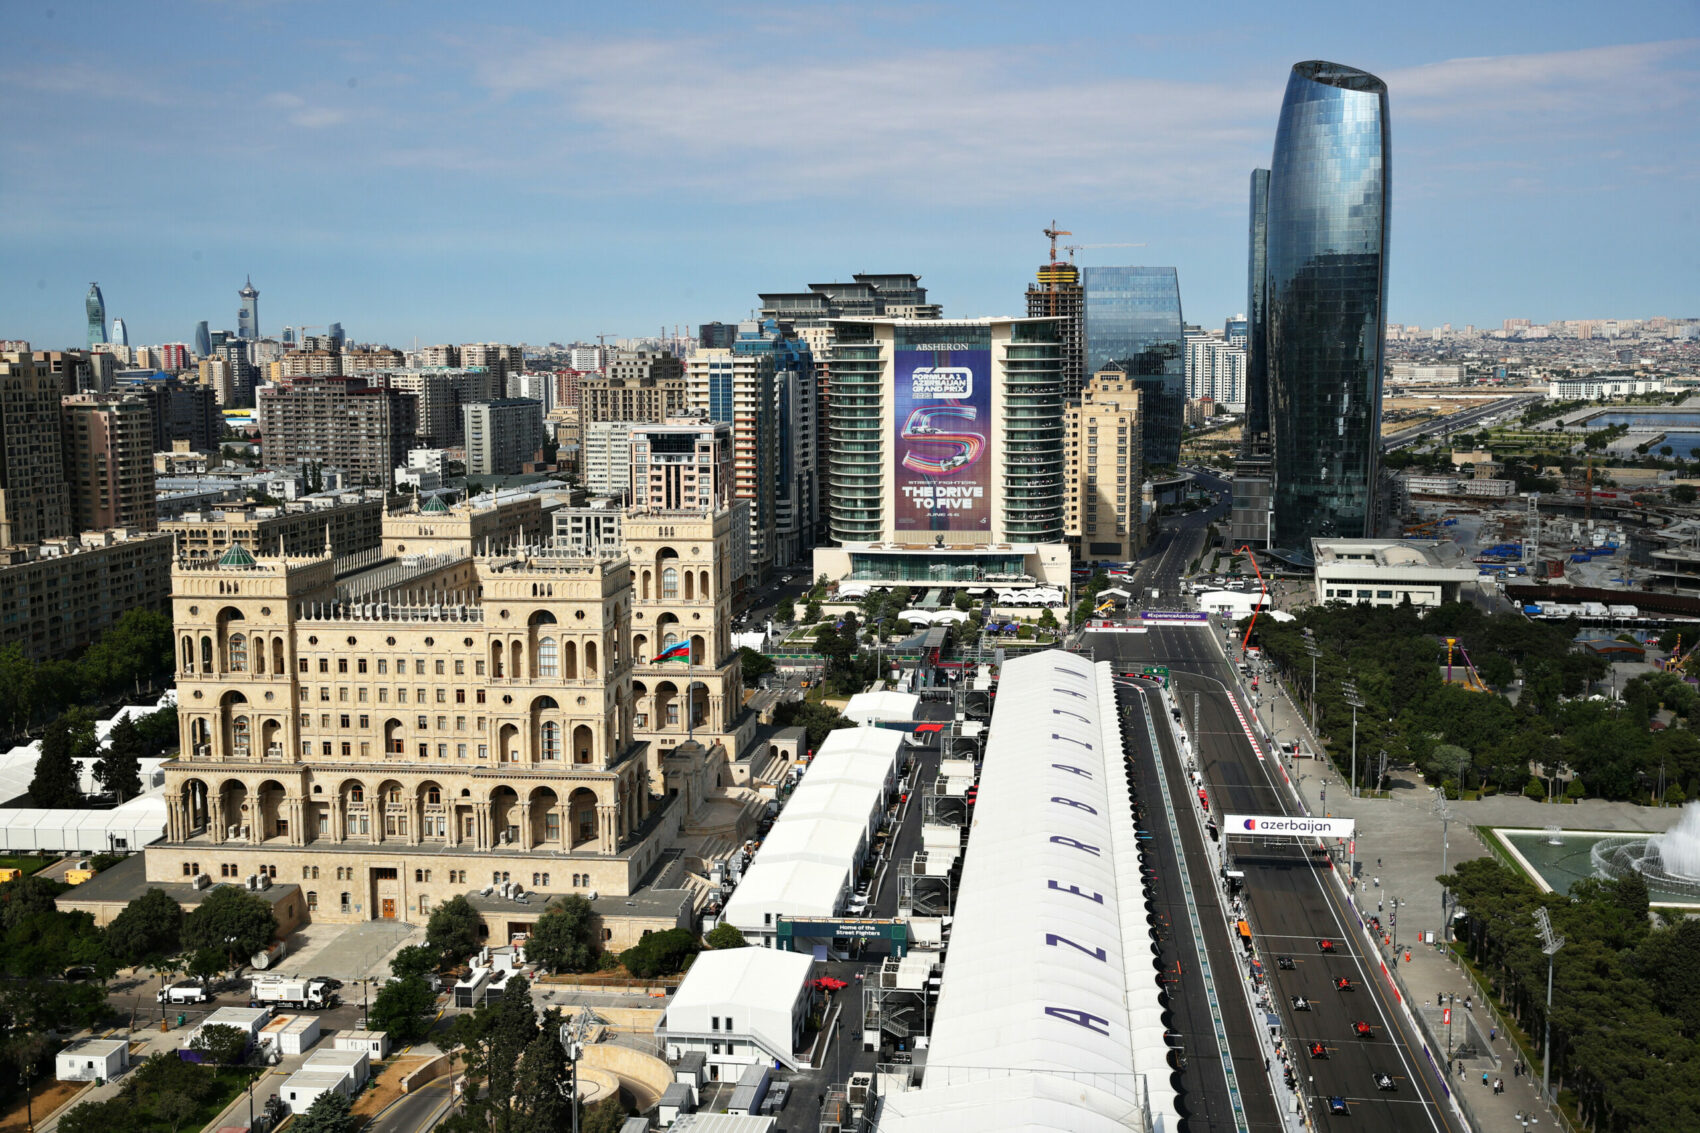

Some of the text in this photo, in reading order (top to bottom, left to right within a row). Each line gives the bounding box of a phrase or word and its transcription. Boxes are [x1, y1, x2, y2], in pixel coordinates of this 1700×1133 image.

[916, 343, 969, 351] ABSHERON
[902, 486, 983, 497] THE DRIVE
[913, 498, 972, 509] TO FIVE
[1260, 819, 1331, 834] azerbaijan
